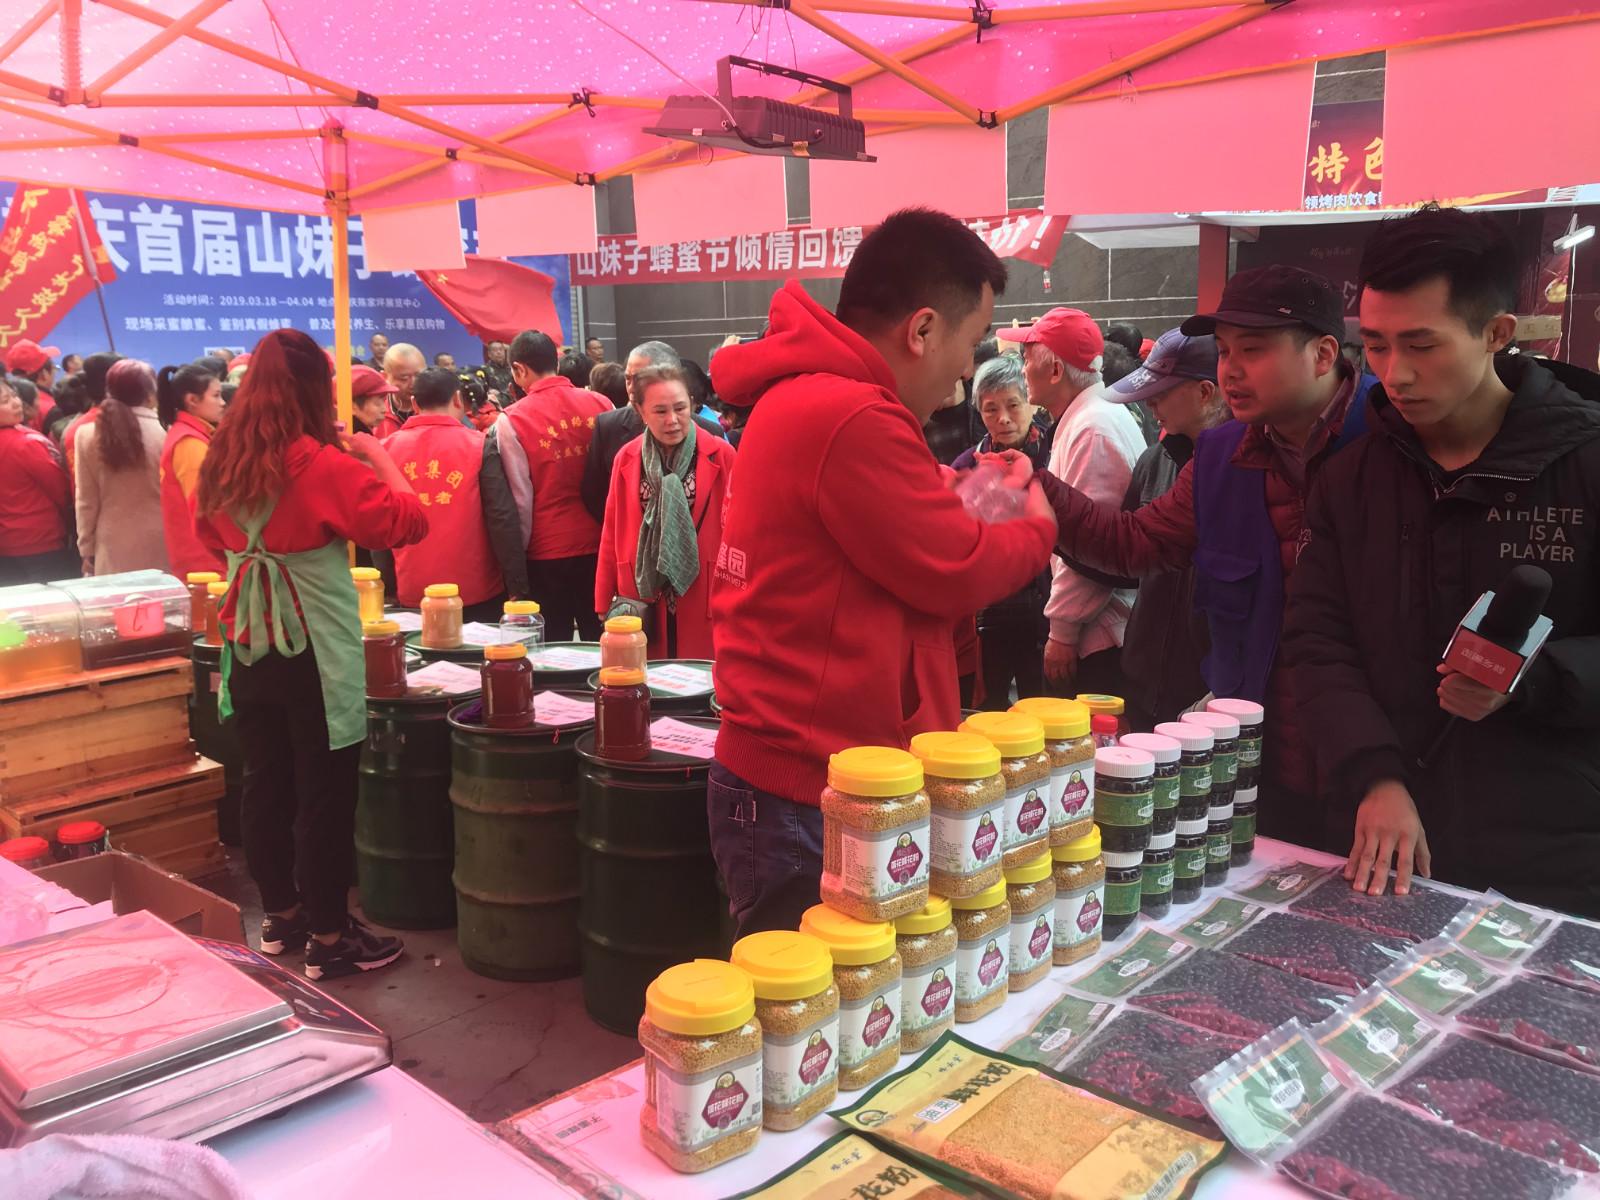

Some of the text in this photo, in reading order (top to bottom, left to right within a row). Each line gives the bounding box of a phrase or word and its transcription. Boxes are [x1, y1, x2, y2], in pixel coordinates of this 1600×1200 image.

[1308, 137, 1383, 184] 特色
[1529, 524, 1567, 542] IS A
[1499, 542, 1576, 563] PLAYER
